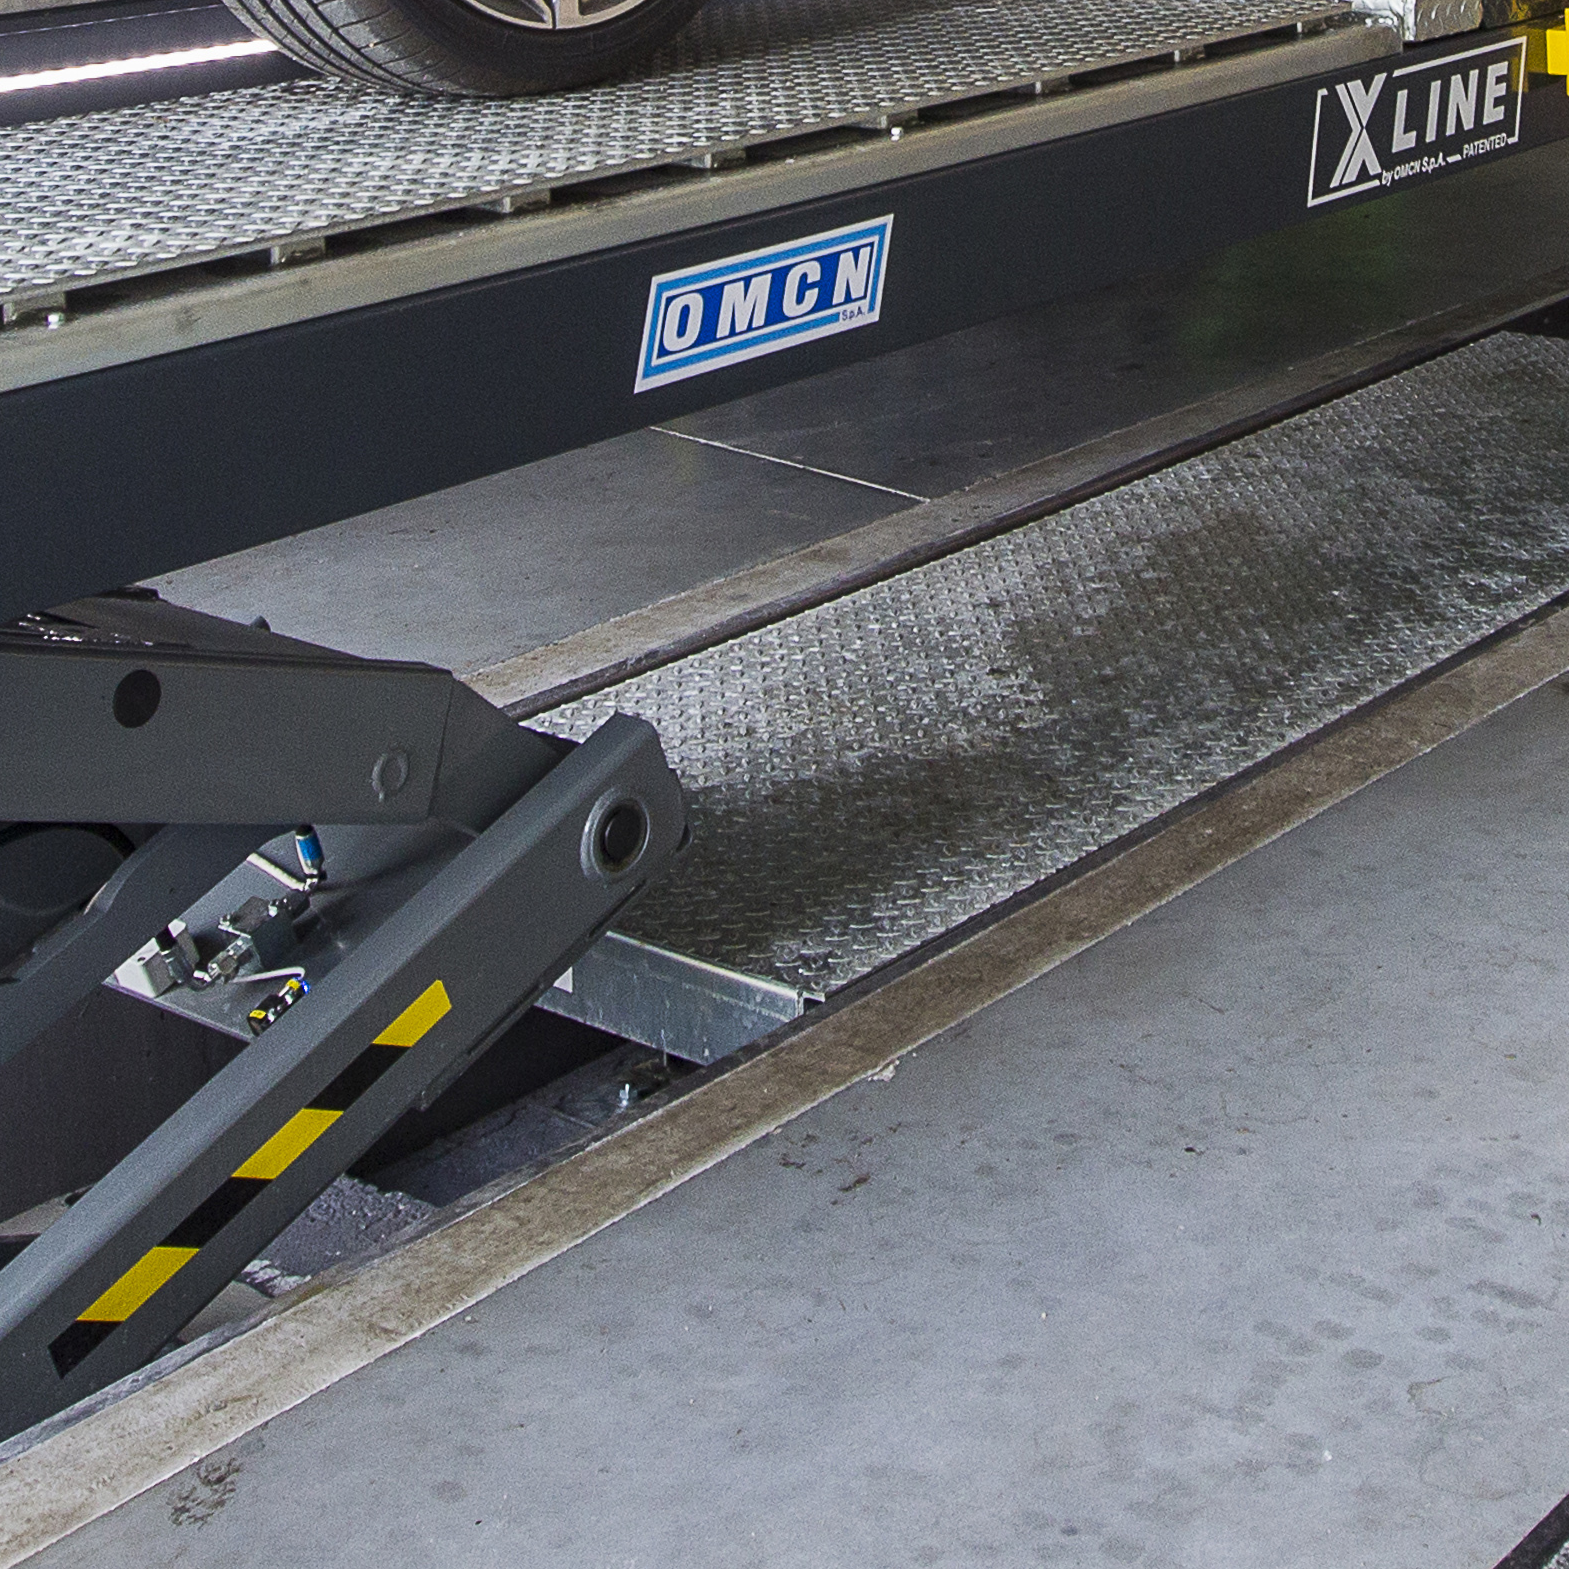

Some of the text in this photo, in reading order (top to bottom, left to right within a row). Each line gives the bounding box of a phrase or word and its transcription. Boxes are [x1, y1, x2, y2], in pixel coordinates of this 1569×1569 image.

[1381, 170, 1394, 187] by
[1393, 159, 1421, 181] OMCN
[1462, 132, 1507, 159] PATENTED
[662, 245, 872, 353] OMCN
